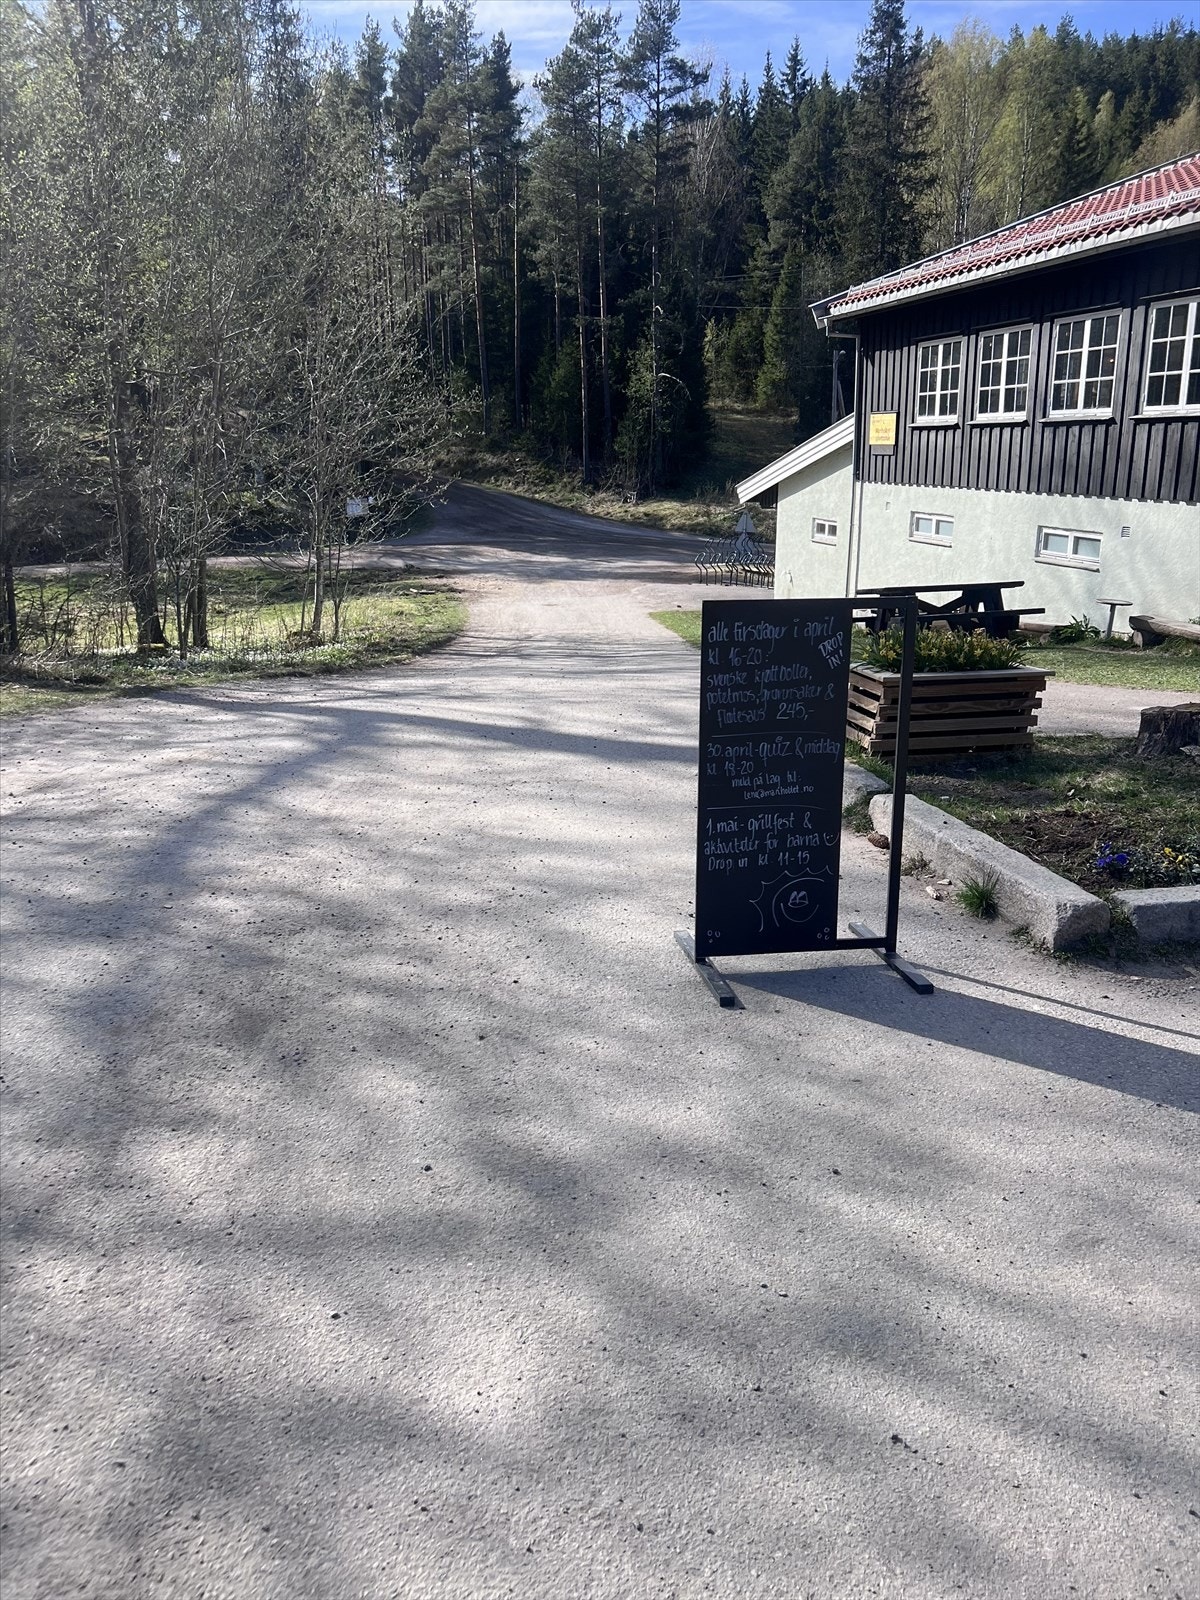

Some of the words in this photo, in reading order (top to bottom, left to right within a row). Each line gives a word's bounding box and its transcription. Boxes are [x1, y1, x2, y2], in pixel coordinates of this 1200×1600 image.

[708, 621, 728, 642] alle
[804, 617, 834, 645] april
[818, 632, 843, 657] DROP
[824, 683, 834, 700] &
[795, 737, 804, 758] &
[748, 812, 795, 839] grillfest
[804, 811, 812, 829] &
[708, 856, 732, 875] Drop
